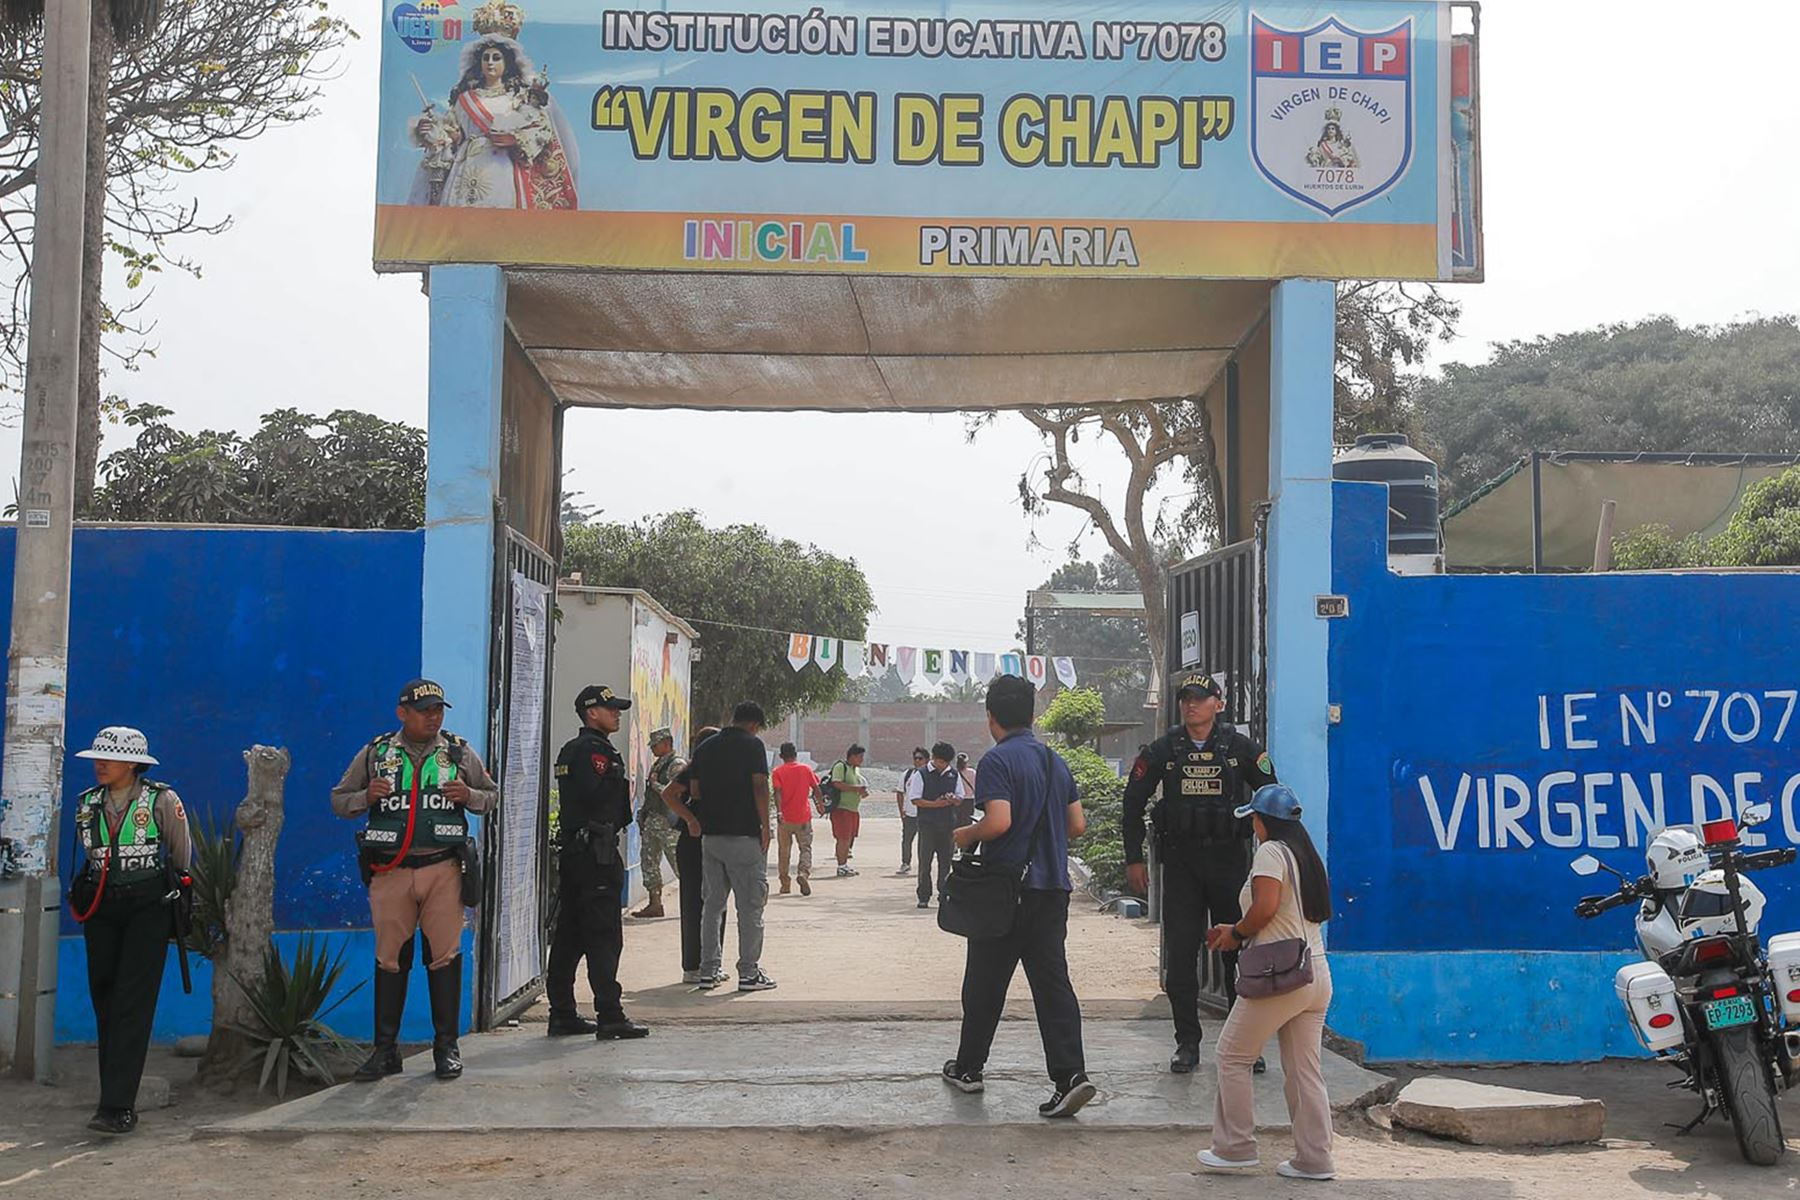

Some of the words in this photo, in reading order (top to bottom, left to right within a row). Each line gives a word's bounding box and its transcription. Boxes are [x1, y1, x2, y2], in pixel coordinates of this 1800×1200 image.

[443, 17, 462, 40] 01
[604, 10, 856, 54] INSTITUCIÓN
[867, 18, 1085, 58] EDUCATIVA
[1270, 87, 1321, 121] VIRGEN
[1328, 86, 1348, 100] DE
[1351, 91, 1392, 124] CHAPI
[893, 93, 984, 166] DE
[1316, 169, 1354, 183] 7078
[683, 218, 868, 264] INICIAL
[919, 226, 1138, 267] PRIMARIA
[790, 634, 1075, 679] BINVENIDOS
[413, 684, 443, 700] POLICIA
[1684, 689, 1799, 744] 707
[1418, 771, 1667, 850] VIRGEN
[1690, 771, 1767, 848] DE
[1707, 1003, 1754, 1024] EP-7293
